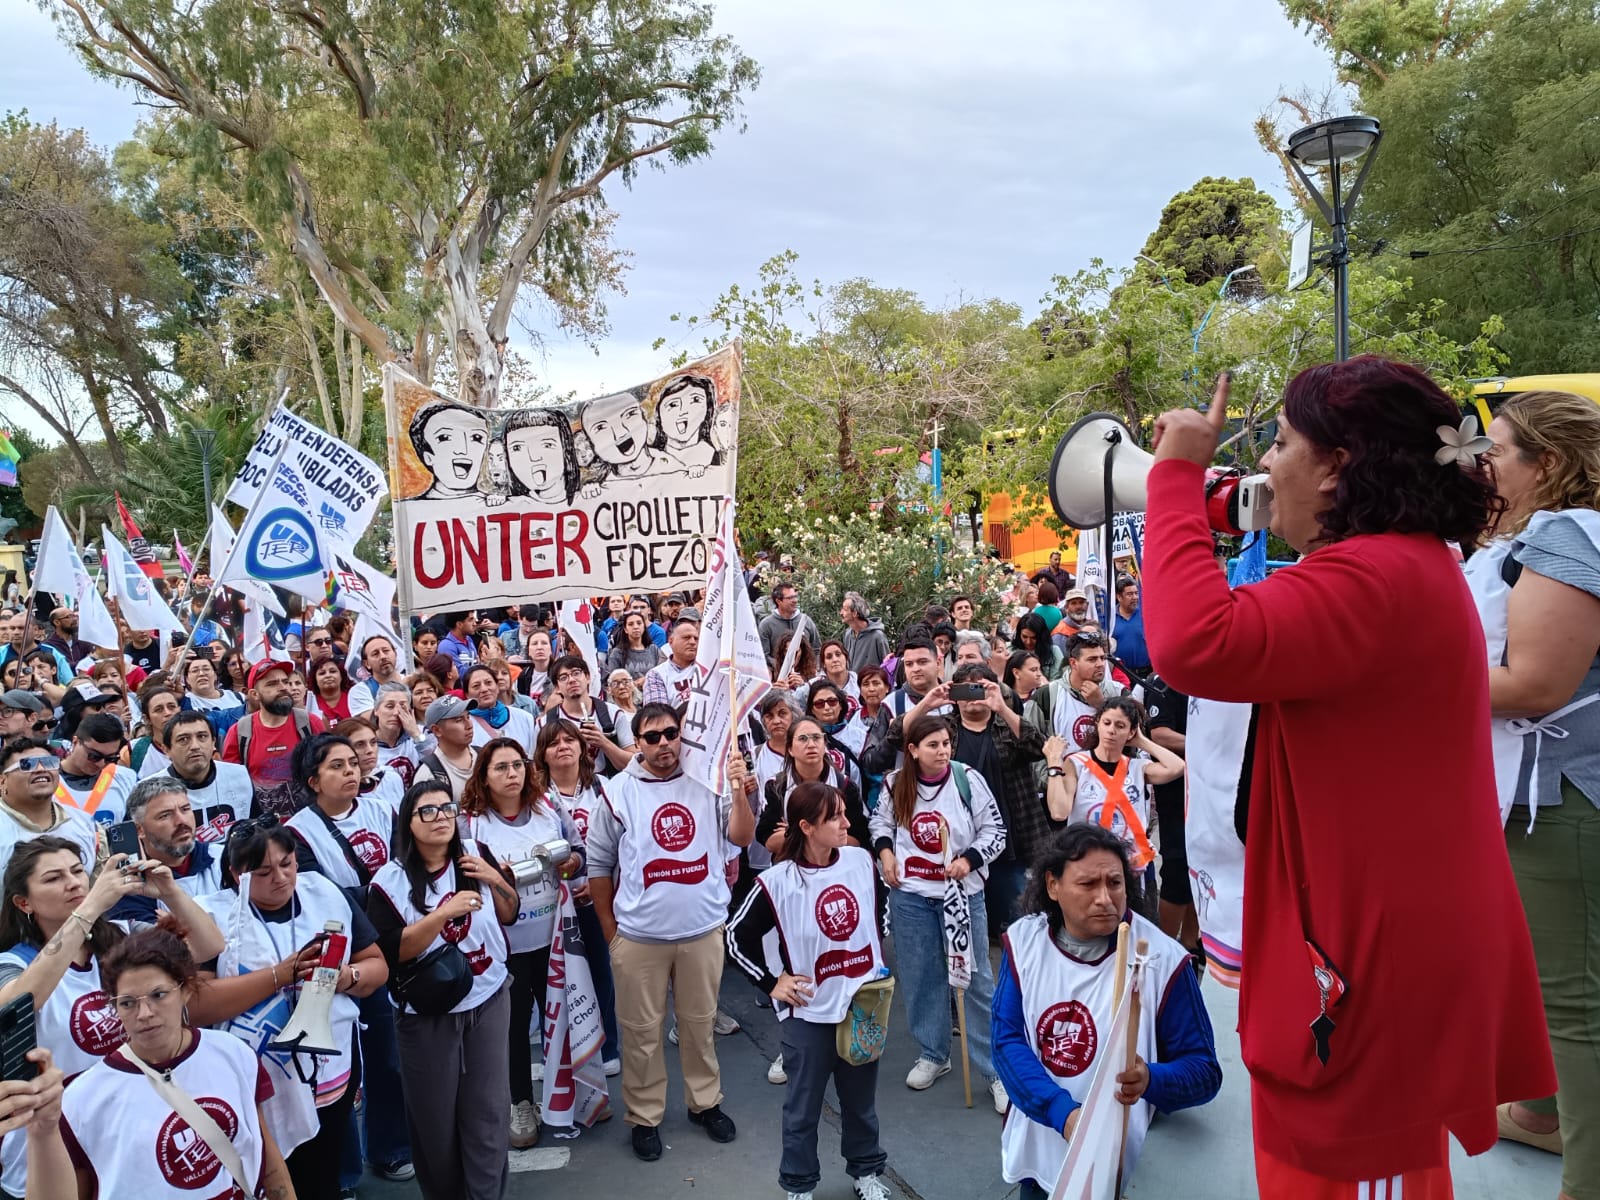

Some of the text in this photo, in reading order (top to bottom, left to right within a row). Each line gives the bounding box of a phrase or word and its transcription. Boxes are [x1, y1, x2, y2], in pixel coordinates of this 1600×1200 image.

[302, 432, 324, 452] EN
[320, 442, 380, 500] DEFENSA
[413, 509, 591, 590] UNTER
[648, 869, 671, 879] UNIÓN
[682, 864, 706, 875] FUERZA
[93, 1041, 111, 1050] VALLE
[184, 1169, 207, 1184] VALLE
